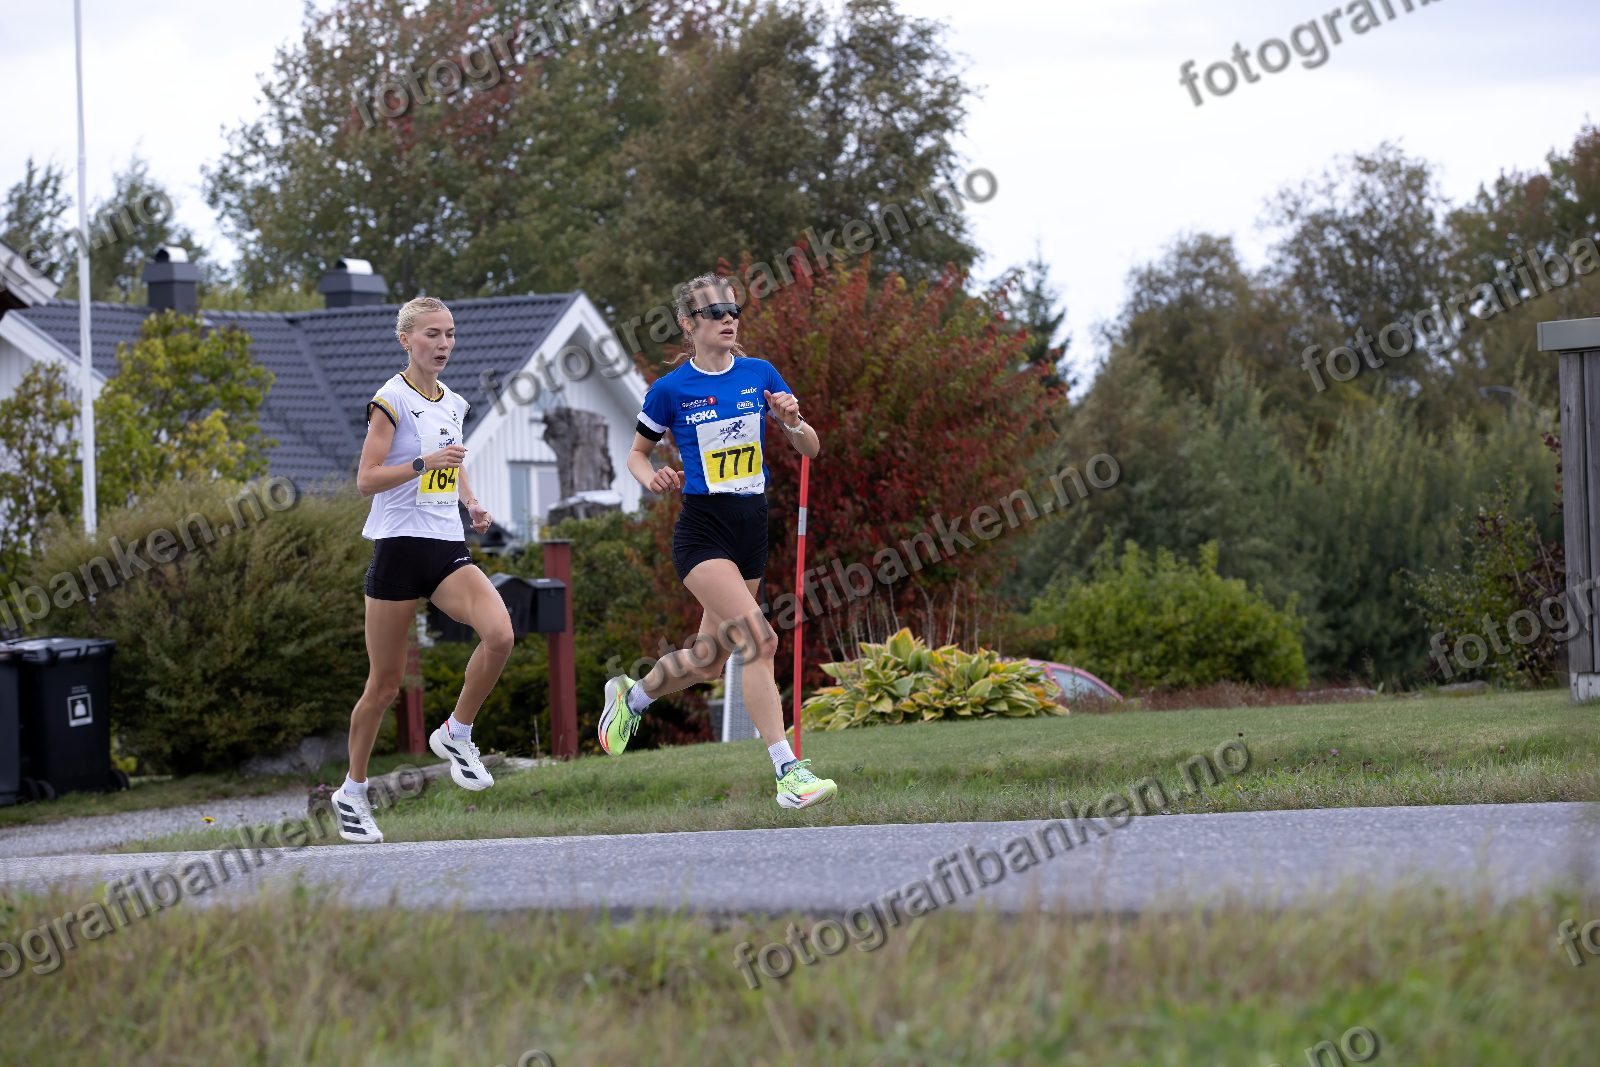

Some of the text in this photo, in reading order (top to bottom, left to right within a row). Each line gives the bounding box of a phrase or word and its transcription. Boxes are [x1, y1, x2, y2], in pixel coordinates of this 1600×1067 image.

[686, 409, 718, 425] HOKA
[712, 446, 755, 478] 777
[427, 467, 456, 490] 764
